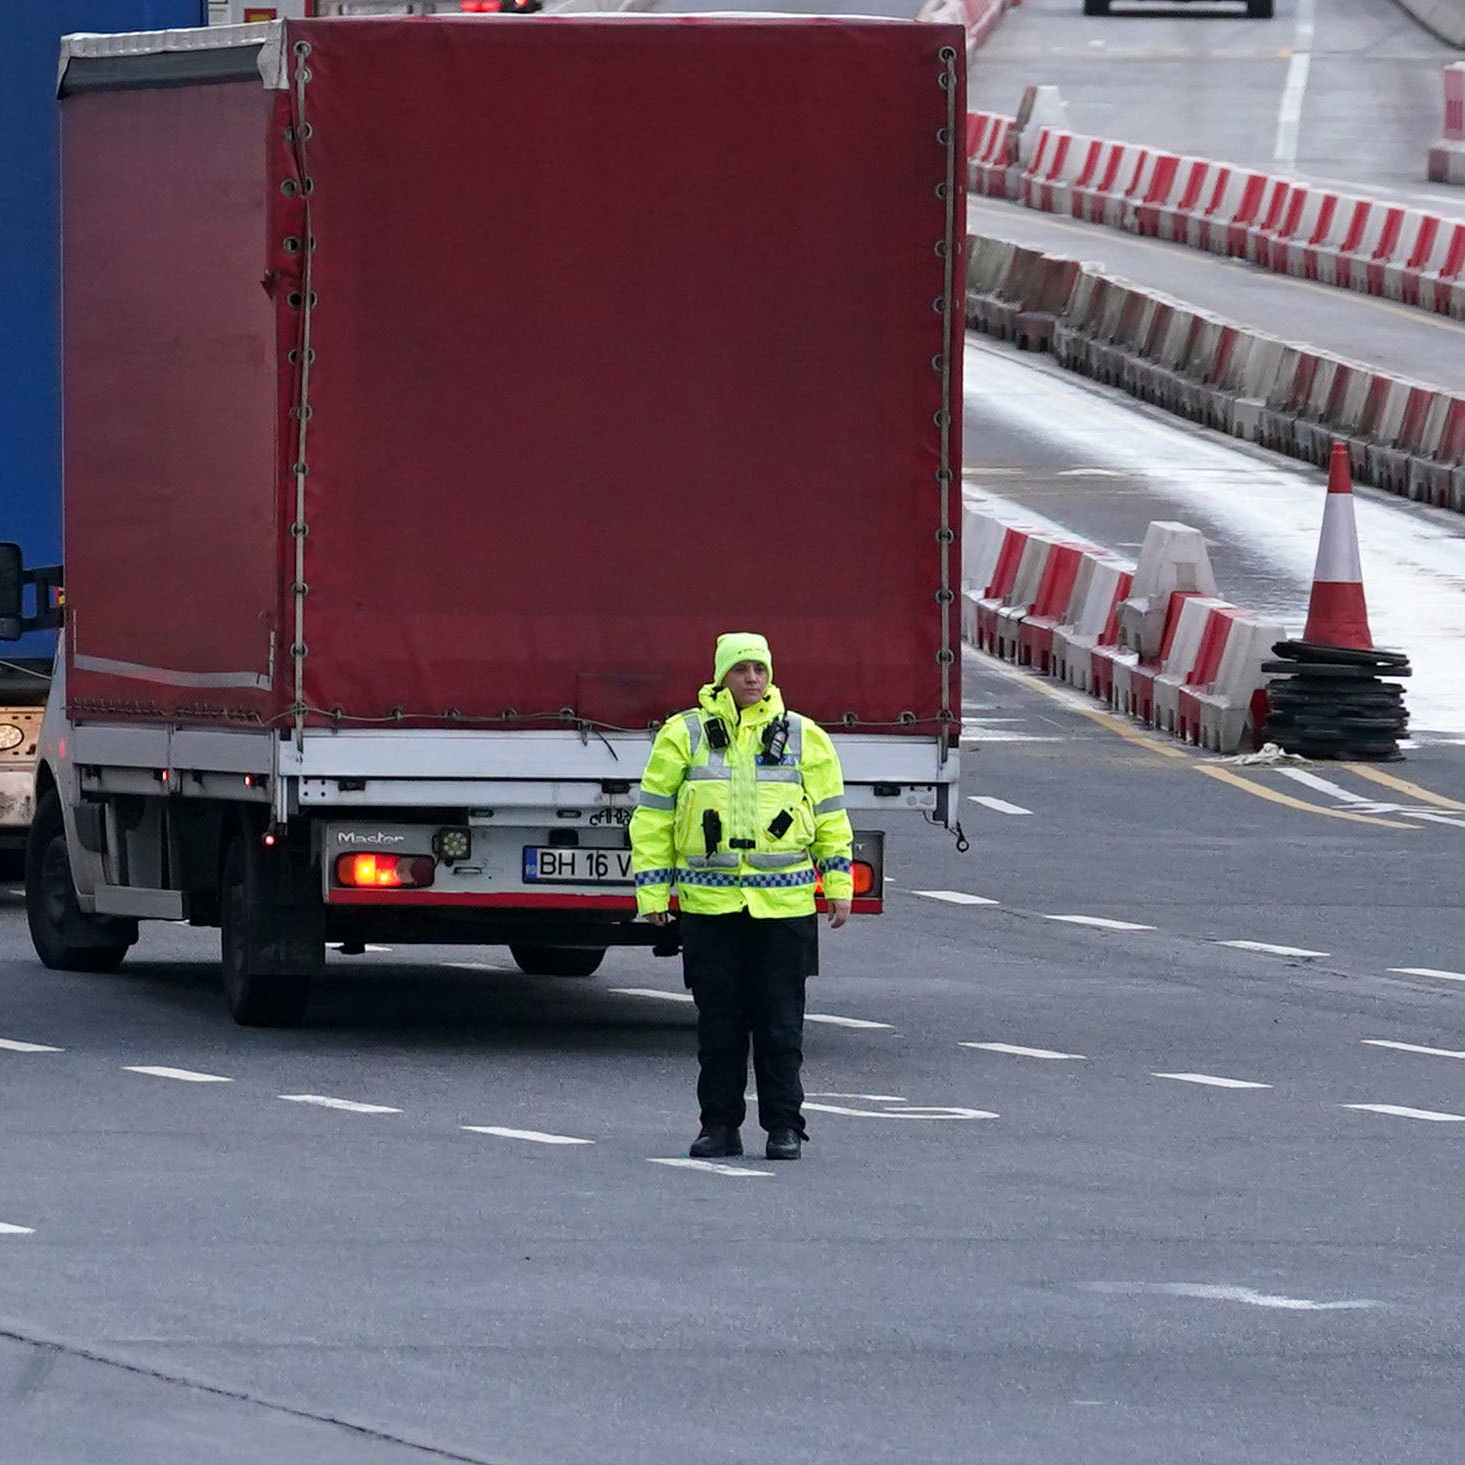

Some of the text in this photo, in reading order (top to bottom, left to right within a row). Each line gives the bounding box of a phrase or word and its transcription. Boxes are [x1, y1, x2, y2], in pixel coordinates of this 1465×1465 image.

[337, 832, 405, 846] Master
[539, 851, 576, 877] BH
[587, 852, 609, 878] 16
